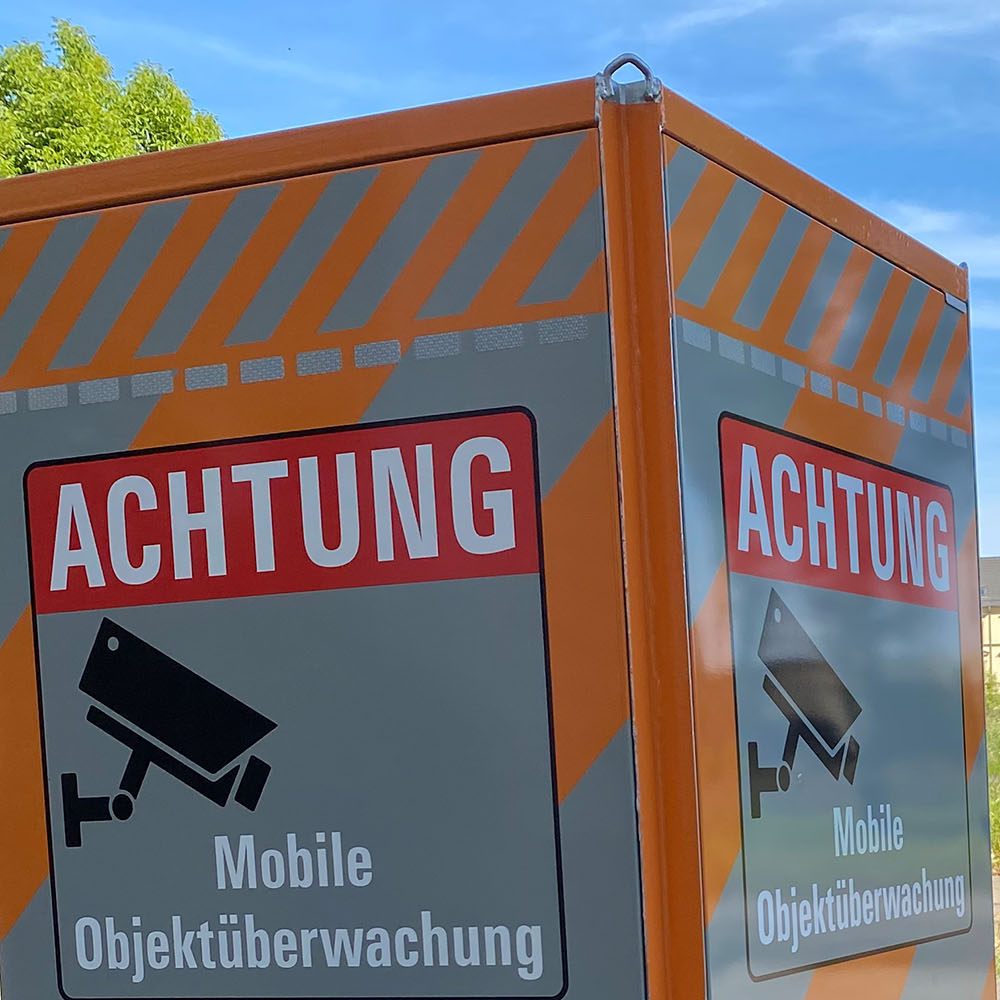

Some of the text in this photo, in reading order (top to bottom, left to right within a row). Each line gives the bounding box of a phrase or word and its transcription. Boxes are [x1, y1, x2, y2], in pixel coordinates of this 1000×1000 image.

[50, 436, 516, 592] ACHTUNG
[736, 443, 951, 593] ACHTUNG
[214, 831, 373, 890] Mobile
[833, 804, 904, 857] Mobile
[74, 911, 543, 983] Objektüberwachung
[757, 868, 965, 953] Objektüberwachung
